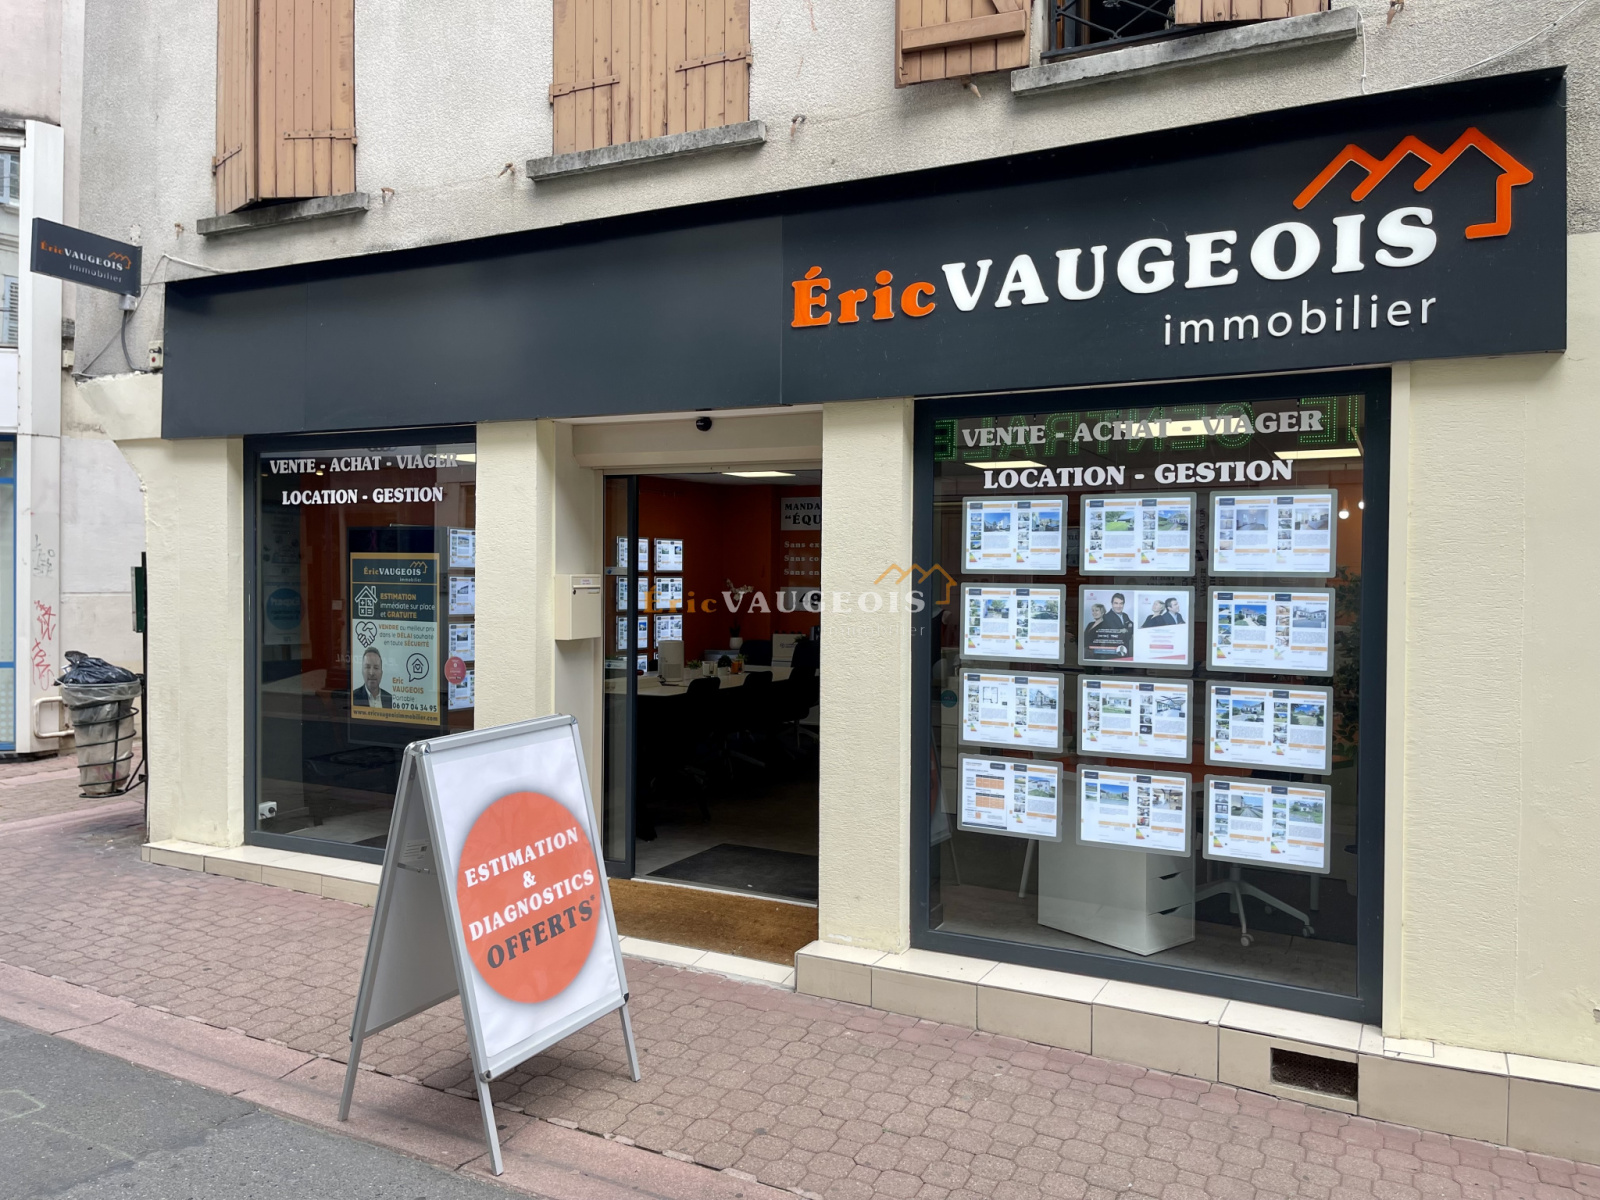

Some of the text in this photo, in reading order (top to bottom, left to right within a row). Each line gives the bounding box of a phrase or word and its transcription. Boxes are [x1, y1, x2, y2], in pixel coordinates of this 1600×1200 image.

[64, 248, 123, 271] VAUGEOIS
[941, 206, 1437, 312] VAUGEOIS
[69, 262, 121, 282] immobilier
[1164, 294, 1437, 346] immobilier
[962, 425, 1046, 447] VENTE
[1072, 418, 1172, 442] ACHAT
[1201, 410, 1324, 436] VIAGER
[269, 458, 317, 474] VENTE
[329, 455, 382, 472] ACHAT
[395, 452, 459, 469] VIAGER
[983, 465, 1126, 489] LOCATION
[1154, 459, 1294, 485] GESTION
[281, 489, 358, 506] LOCATION
[372, 486, 444, 503] GESTION
[379, 567, 421, 576] VAUGEOIS
[380, 593, 417, 601] ESTIMATION
[387, 611, 418, 619] GRATUITE
[419, 603, 436, 612] place
[379, 623, 399, 631] VENDRE
[396, 631, 413, 639] DÉLAI
[404, 640, 430, 648] SÉCURITÉ
[392, 685, 424, 695] VAUGEOIS
[464, 826, 579, 888] ESTIMATION
[522, 870, 537, 889] &
[468, 868, 595, 942] DIAGNOSTICS
